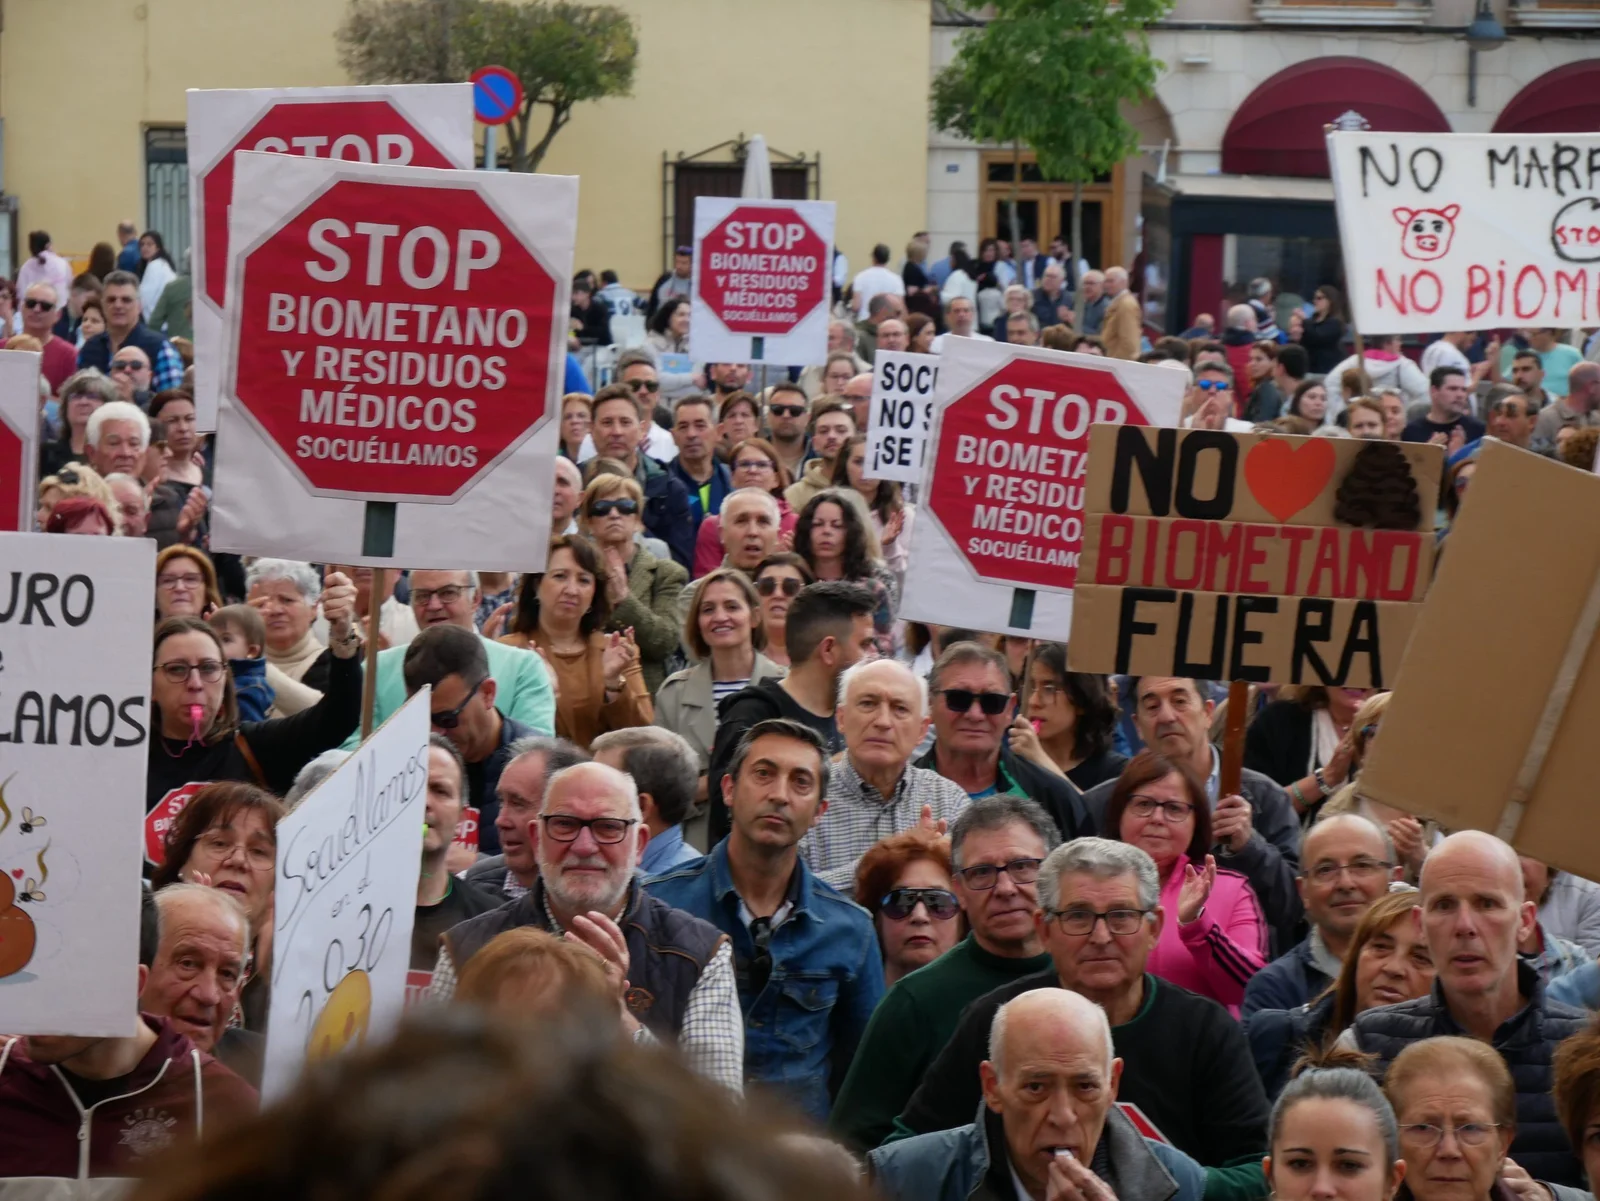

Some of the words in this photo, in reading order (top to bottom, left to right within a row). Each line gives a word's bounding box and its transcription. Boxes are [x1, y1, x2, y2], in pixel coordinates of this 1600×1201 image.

[1358, 143, 1443, 197] NO
[304, 218, 502, 291] STOP
[724, 221, 806, 250] STOP
[709, 252, 817, 273] BIOMETANO
[716, 275, 727, 288] Y
[729, 273, 809, 291] RESIDUOS
[723, 288, 798, 309] MÉDICOS
[1376, 268, 1443, 315] NO
[267, 292, 528, 349] BIOMETANO
[722, 309, 798, 323] SOCUÉLLAMOS
[281, 349, 305, 377] Y
[314, 345, 508, 391] RESIDUOS
[299, 384, 478, 433] MÉDICOS
[879, 398, 915, 430] NO
[295, 434, 478, 468] SOCUÉLLAMOS
[872, 435, 913, 471] ¡SE
[963, 474, 980, 496] Y
[1110, 425, 1240, 520] NO
[971, 502, 1085, 543] MÉDICO
[1095, 514, 1423, 602] BIOMETANO
[1115, 587, 1383, 689] FUERA
